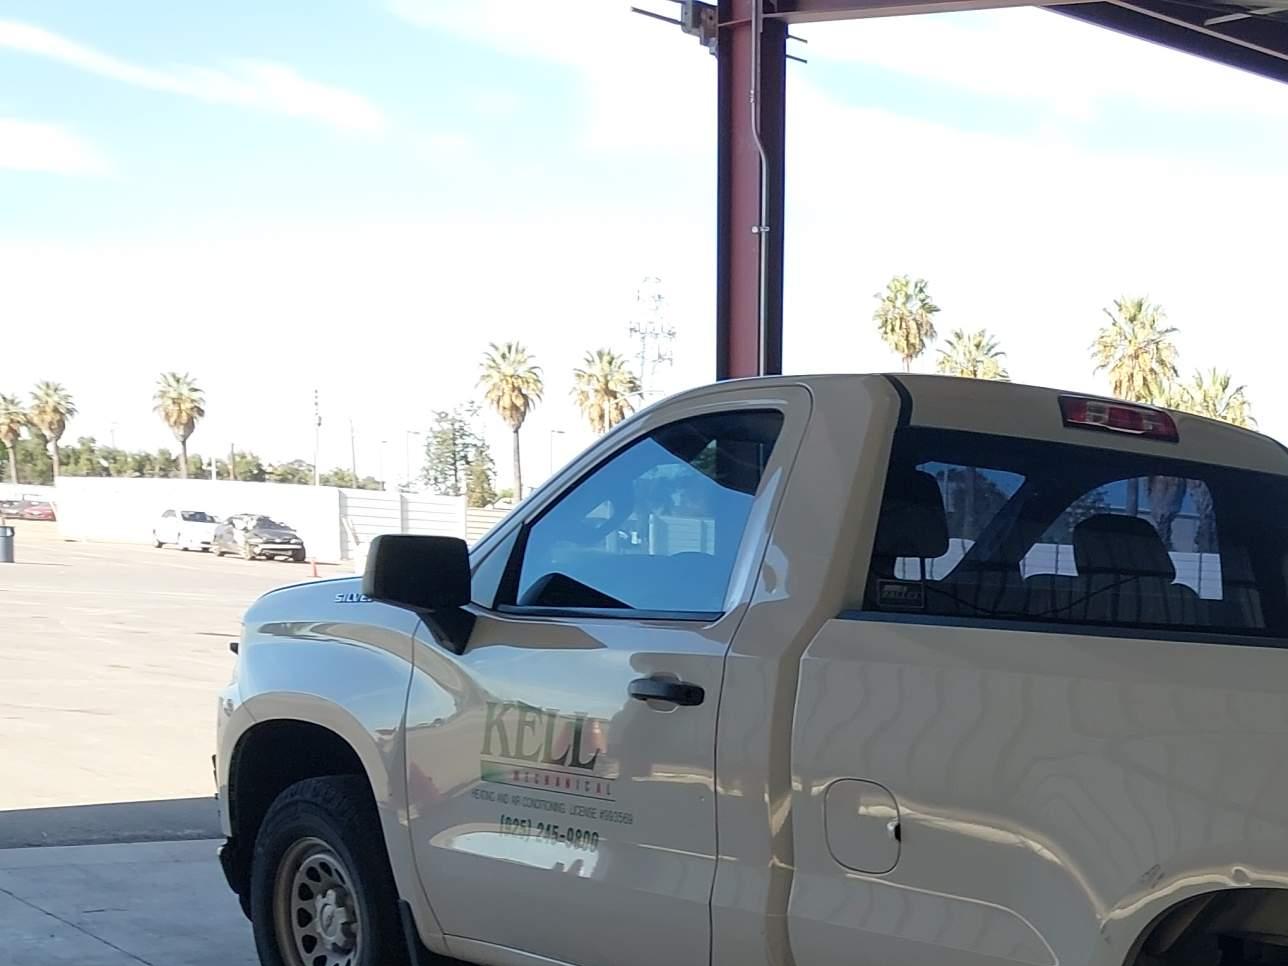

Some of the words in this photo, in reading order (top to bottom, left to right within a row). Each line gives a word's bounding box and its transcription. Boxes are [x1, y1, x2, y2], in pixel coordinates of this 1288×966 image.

[334, 592, 372, 603] SILVE
[480, 700, 600, 770] KELL
[512, 770, 611, 795] MECHANICAL
